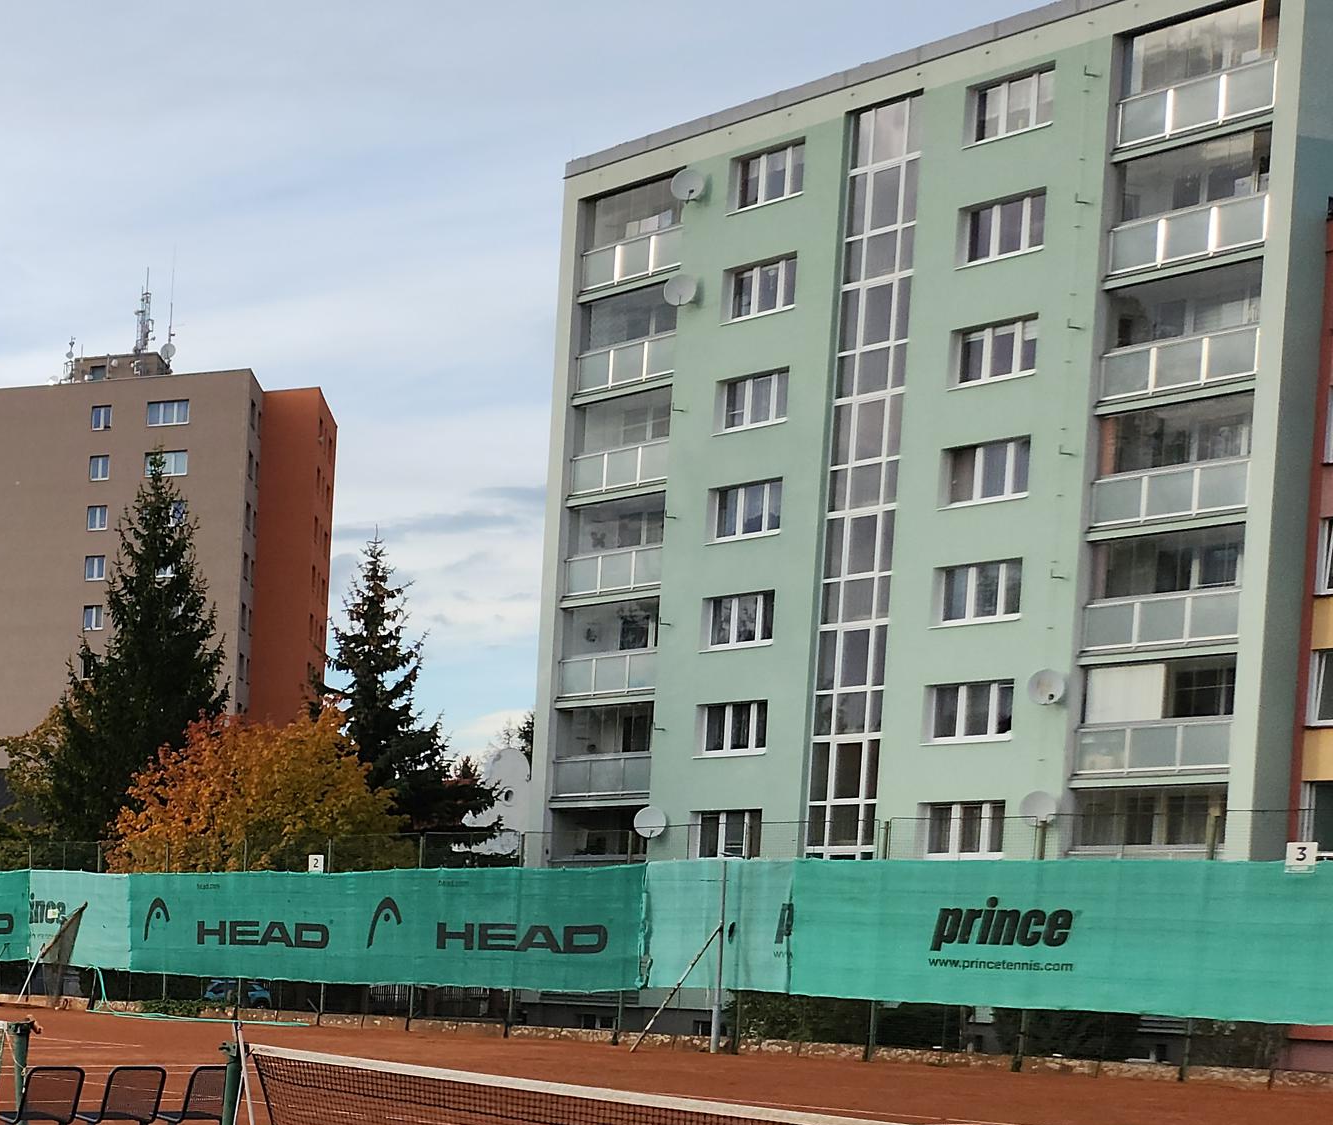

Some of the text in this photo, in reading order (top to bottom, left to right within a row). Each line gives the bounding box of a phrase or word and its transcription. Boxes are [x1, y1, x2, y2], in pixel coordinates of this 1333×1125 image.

[313, 858, 319, 868] 2
[1295, 846, 1307, 861] 3
[197, 920, 329, 949] HEAD
[930, 896, 1073, 951] prince
[437, 922, 608, 954] HEAD
[928, 958, 1073, 972] www.princetennis.com
